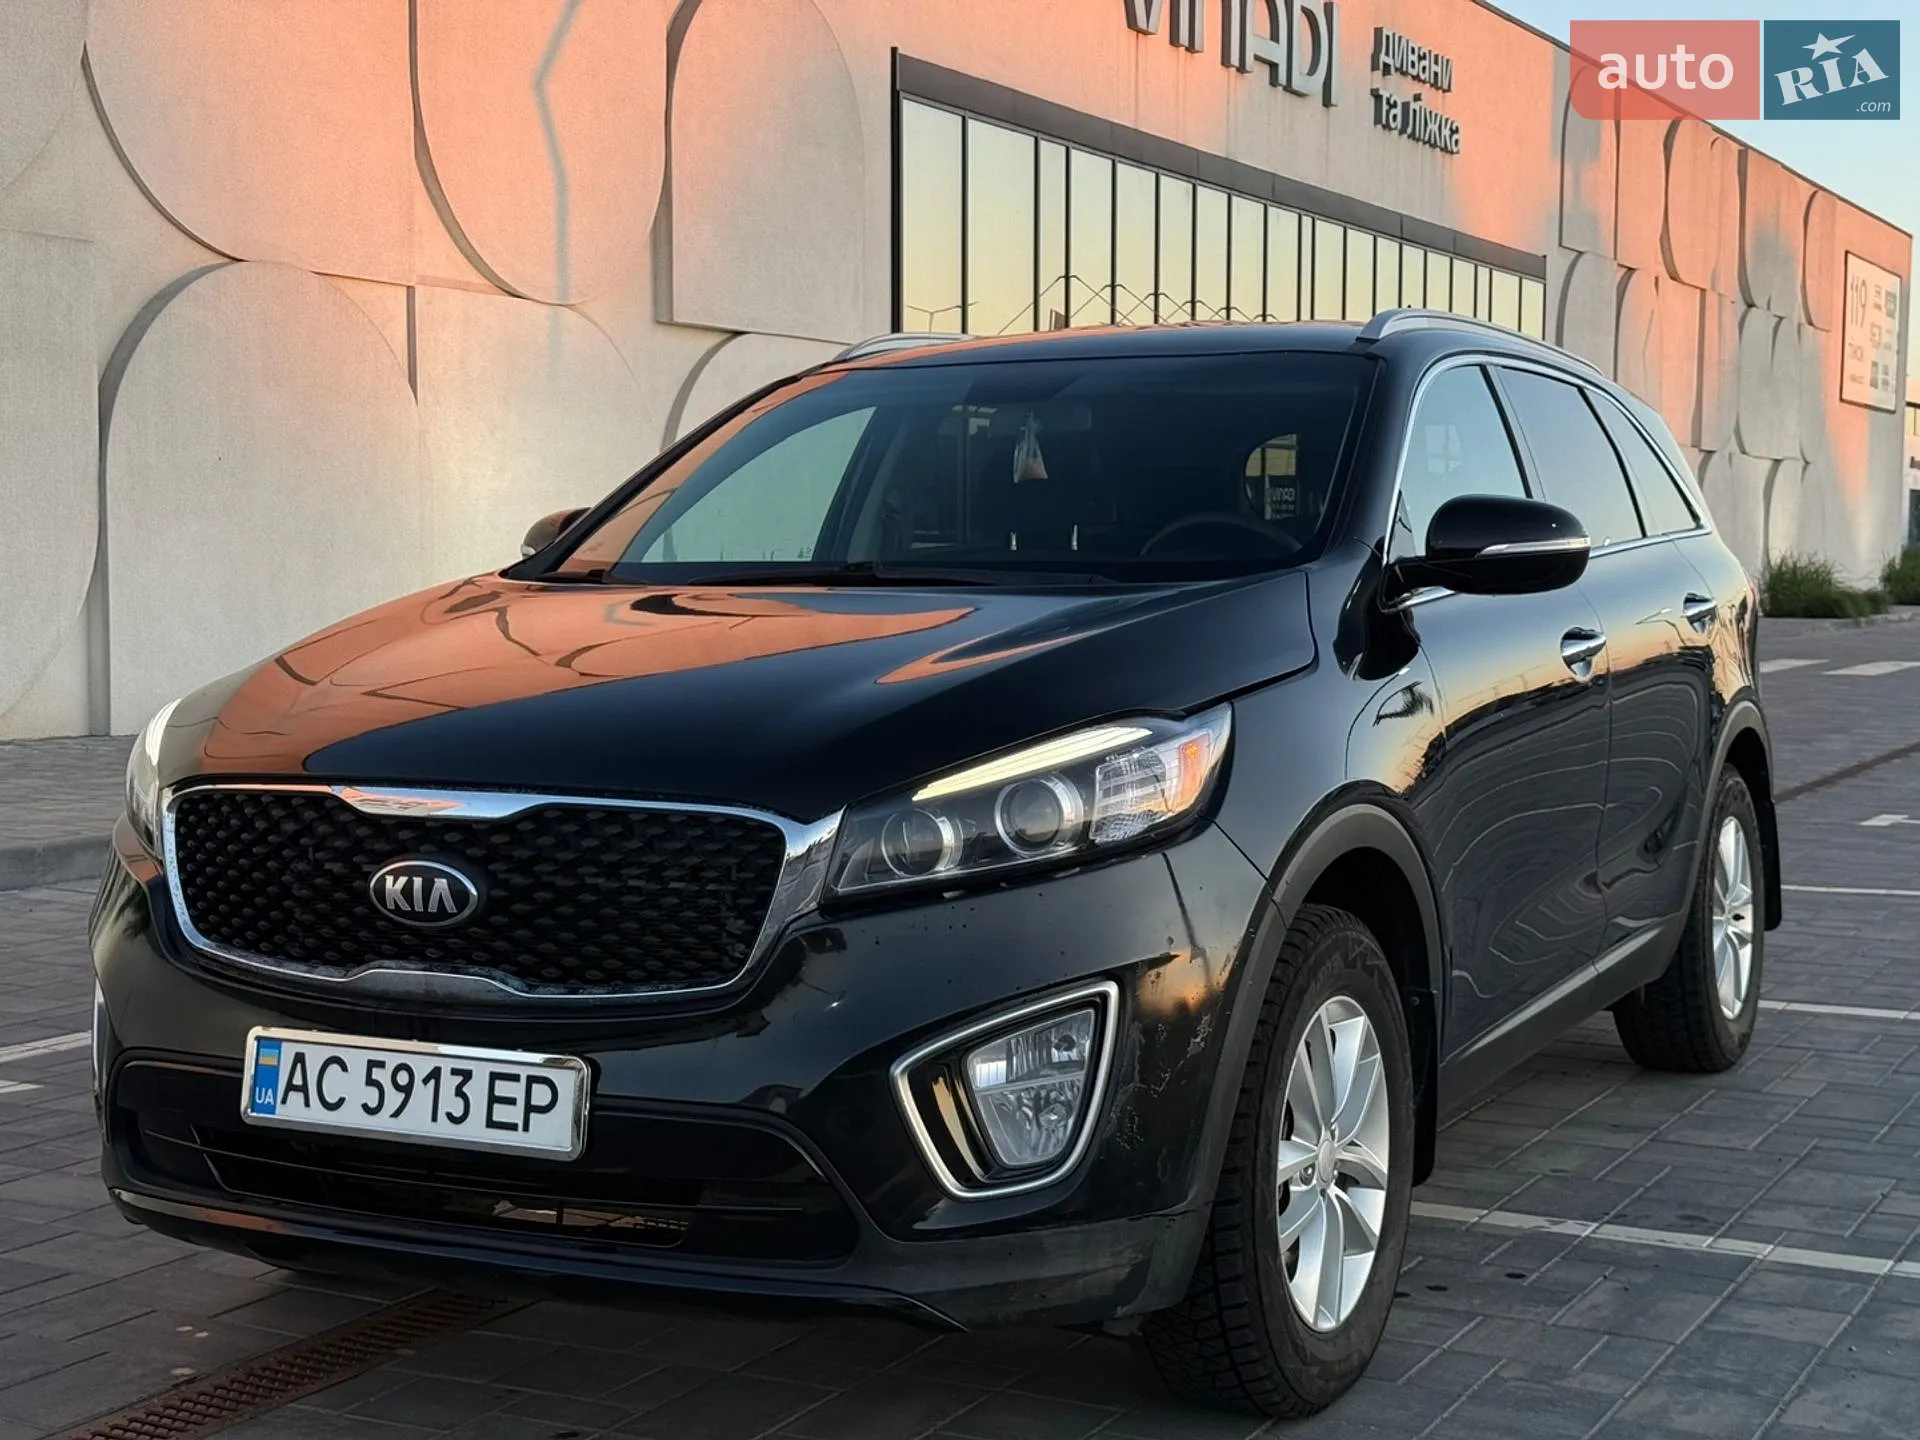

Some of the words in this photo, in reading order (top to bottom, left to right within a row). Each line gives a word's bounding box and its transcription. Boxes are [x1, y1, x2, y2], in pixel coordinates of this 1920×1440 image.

[1374, 26, 1453, 92] дивани
[1371, 87, 1401, 130] та
[1403, 93, 1460, 155] ліжка
[385, 874, 457, 913] KIA
[255, 1086, 275, 1105] UA
[280, 1051, 349, 1112] AC
[361, 1058, 474, 1126] 5913
[485, 1070, 560, 1133] EP
